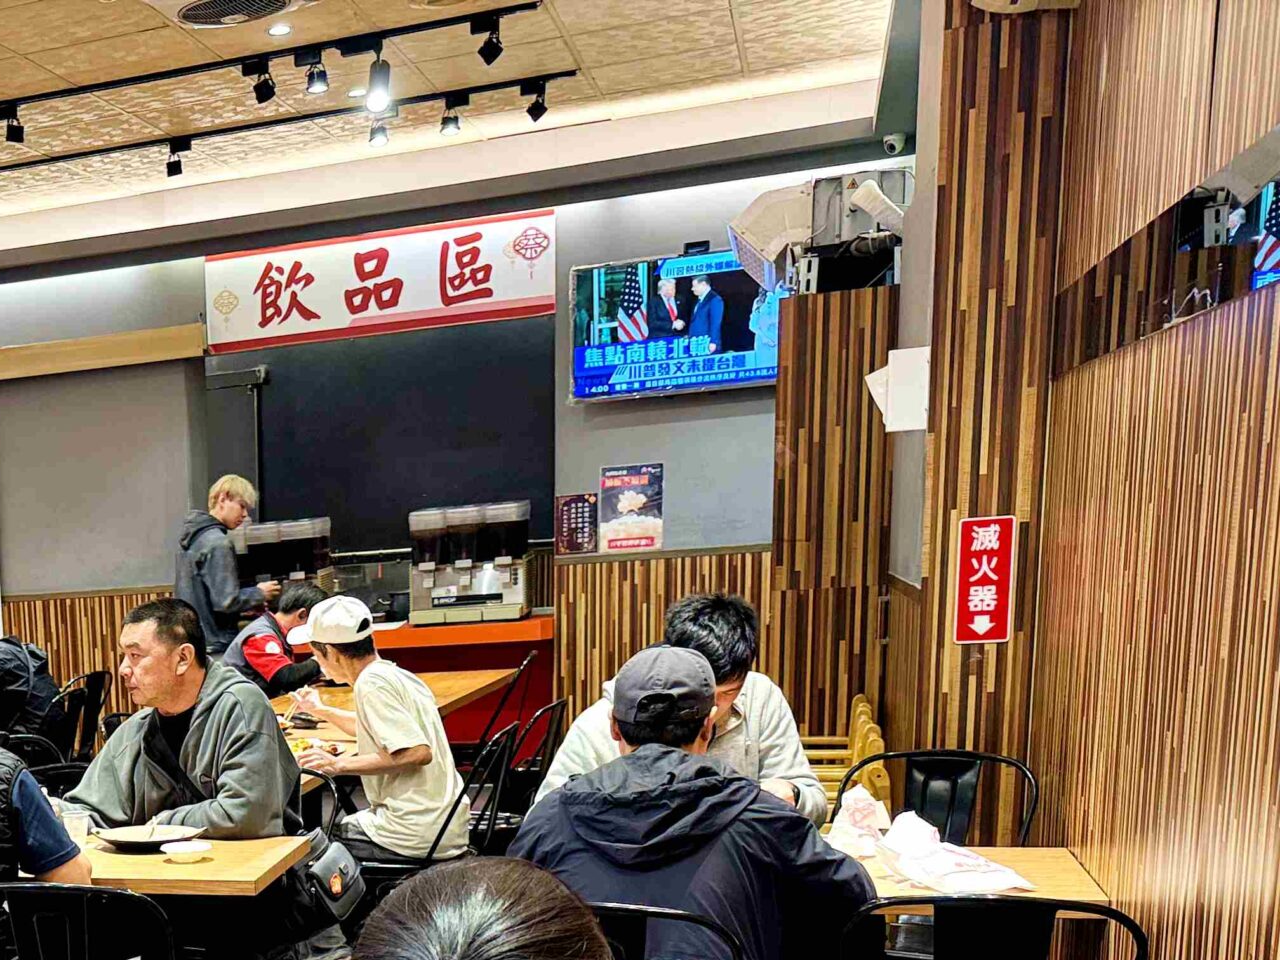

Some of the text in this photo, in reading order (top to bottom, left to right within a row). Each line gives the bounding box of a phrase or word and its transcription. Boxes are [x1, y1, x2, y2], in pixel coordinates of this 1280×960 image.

[253, 231, 493, 328] 飲品區
[968, 523, 1000, 611] 滅火器
